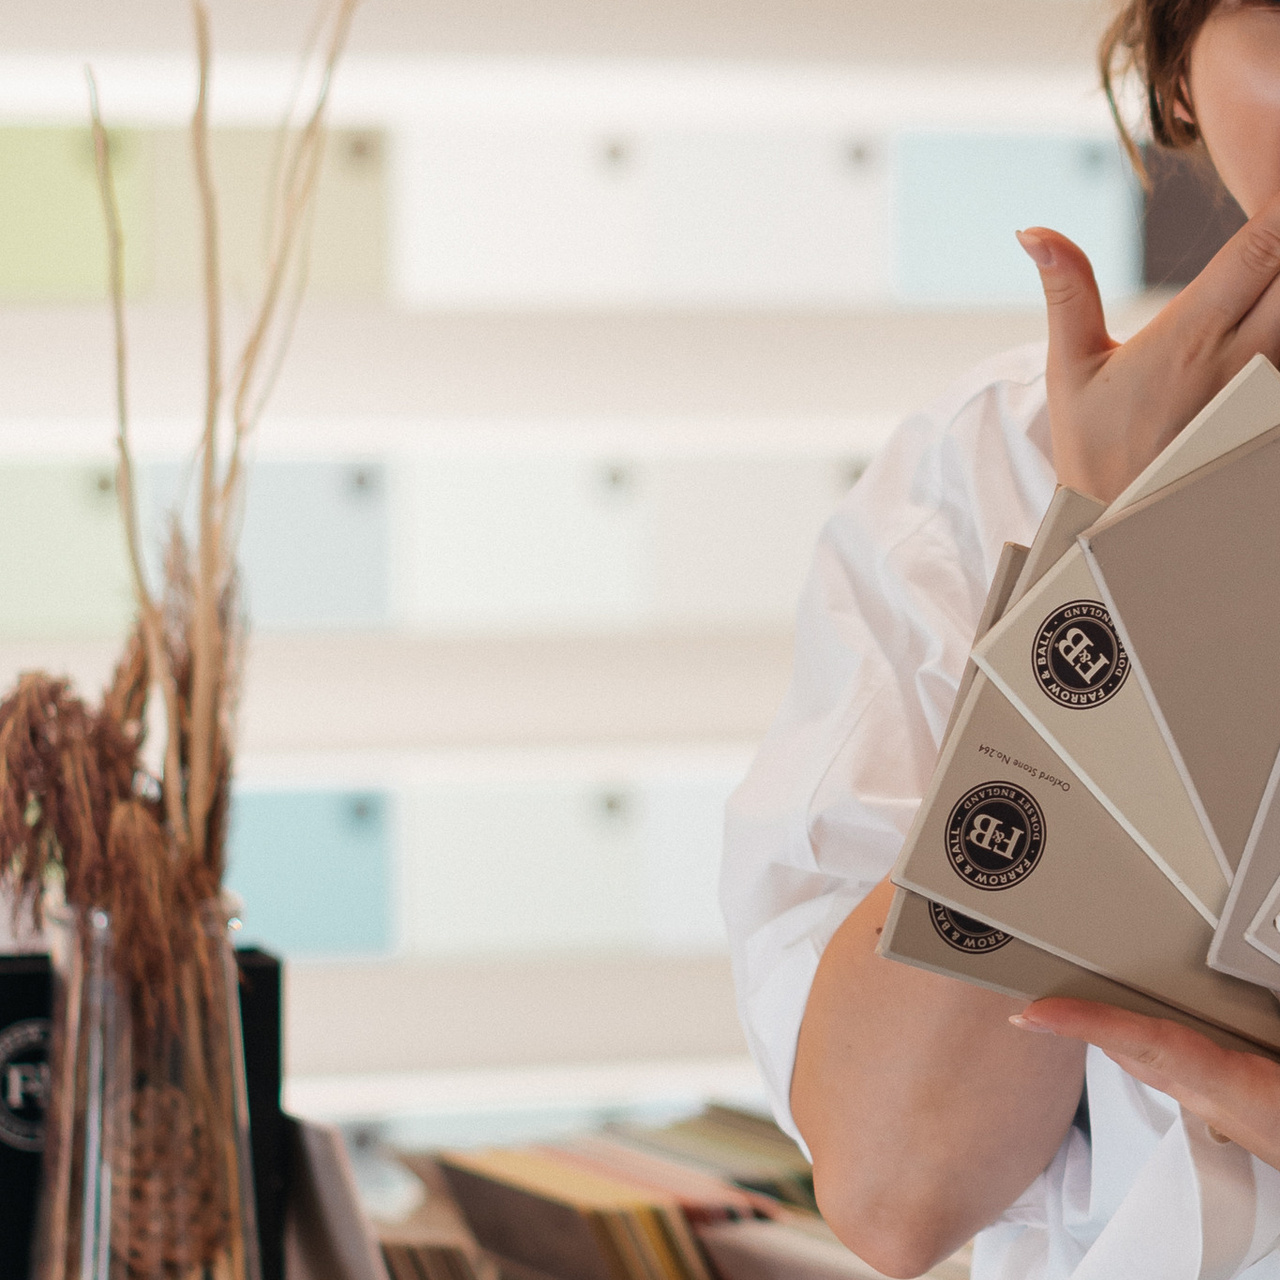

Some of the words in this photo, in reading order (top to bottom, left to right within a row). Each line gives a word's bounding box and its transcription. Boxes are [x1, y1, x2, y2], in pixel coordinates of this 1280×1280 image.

[1037, 630, 1053, 665] BALL
[1058, 627, 1110, 684] F&B
[1041, 670, 1051, 680] &
[1048, 683, 1105, 703] FARROW
[978, 744, 1011, 765] No.264
[1013, 758, 1038, 777] Stone
[1038, 771, 1071, 792] Oxford
[964, 787, 1016, 810] ENGLAND
[1017, 797, 1040, 840] DORSET
[950, 827, 965, 864] BALL
[969, 813, 1025, 860] F&B
[964, 864, 974, 874] &
[974, 858, 1031, 885] FARROW
[935, 904, 951, 931] BAL
[951, 930, 960, 940] &
[963, 931, 1005, 948] RROW
